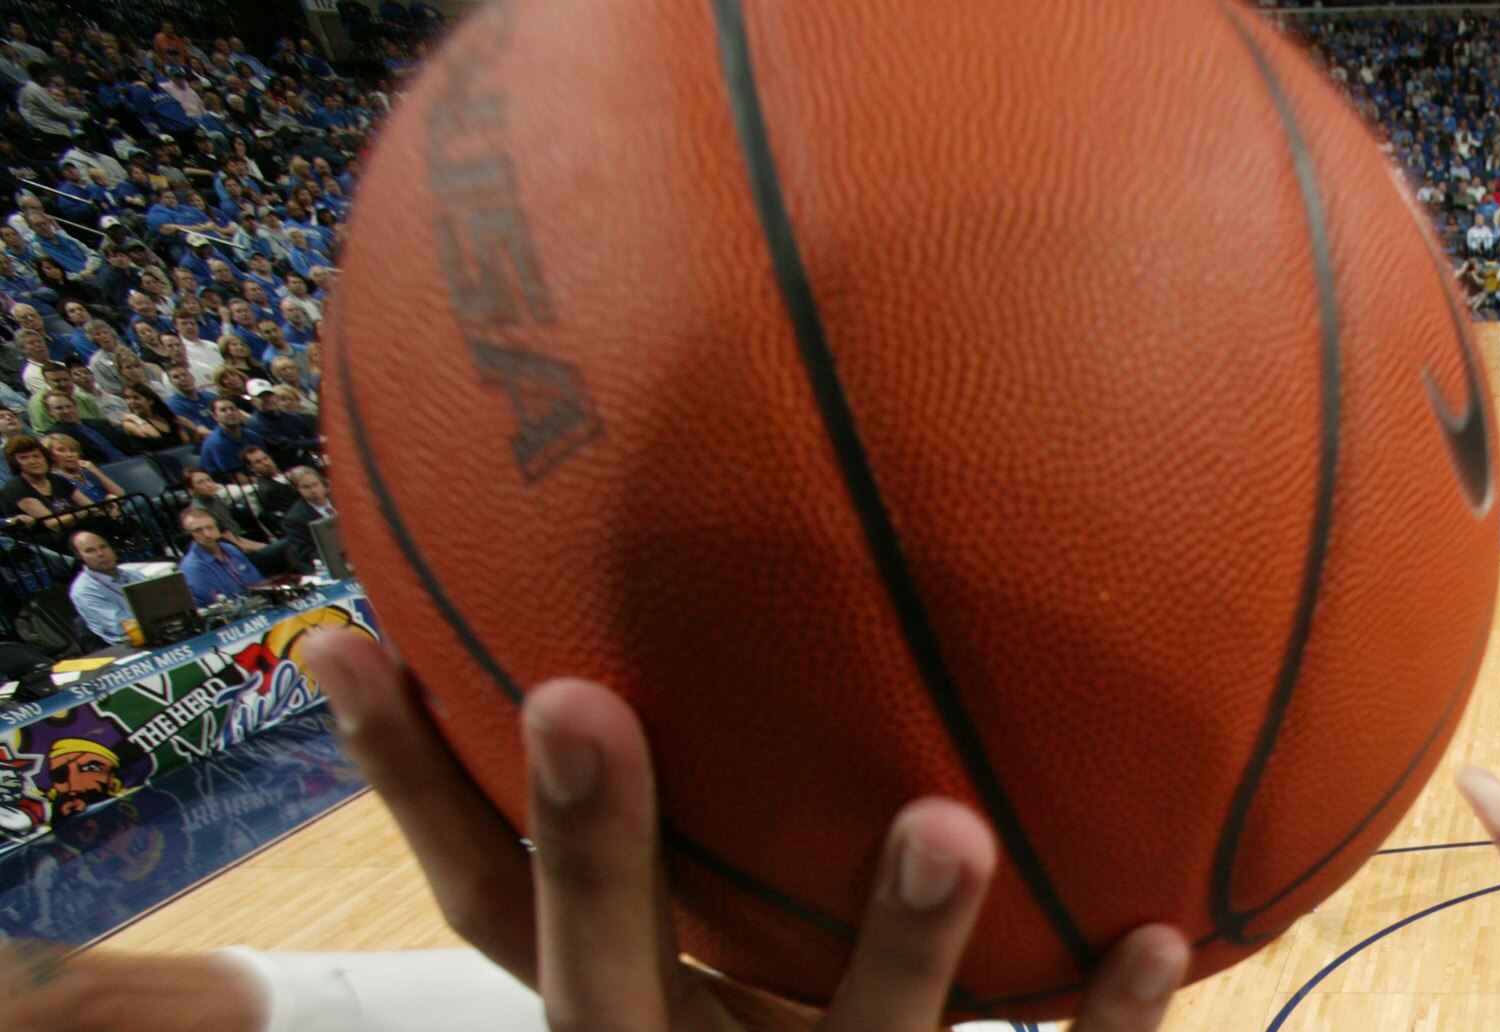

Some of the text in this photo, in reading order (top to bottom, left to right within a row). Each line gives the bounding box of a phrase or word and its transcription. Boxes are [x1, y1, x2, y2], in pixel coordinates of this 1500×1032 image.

[153, 645, 195, 669] MISS
[1, 702, 43, 725] SMU
[128, 677, 229, 754] THE HERD
